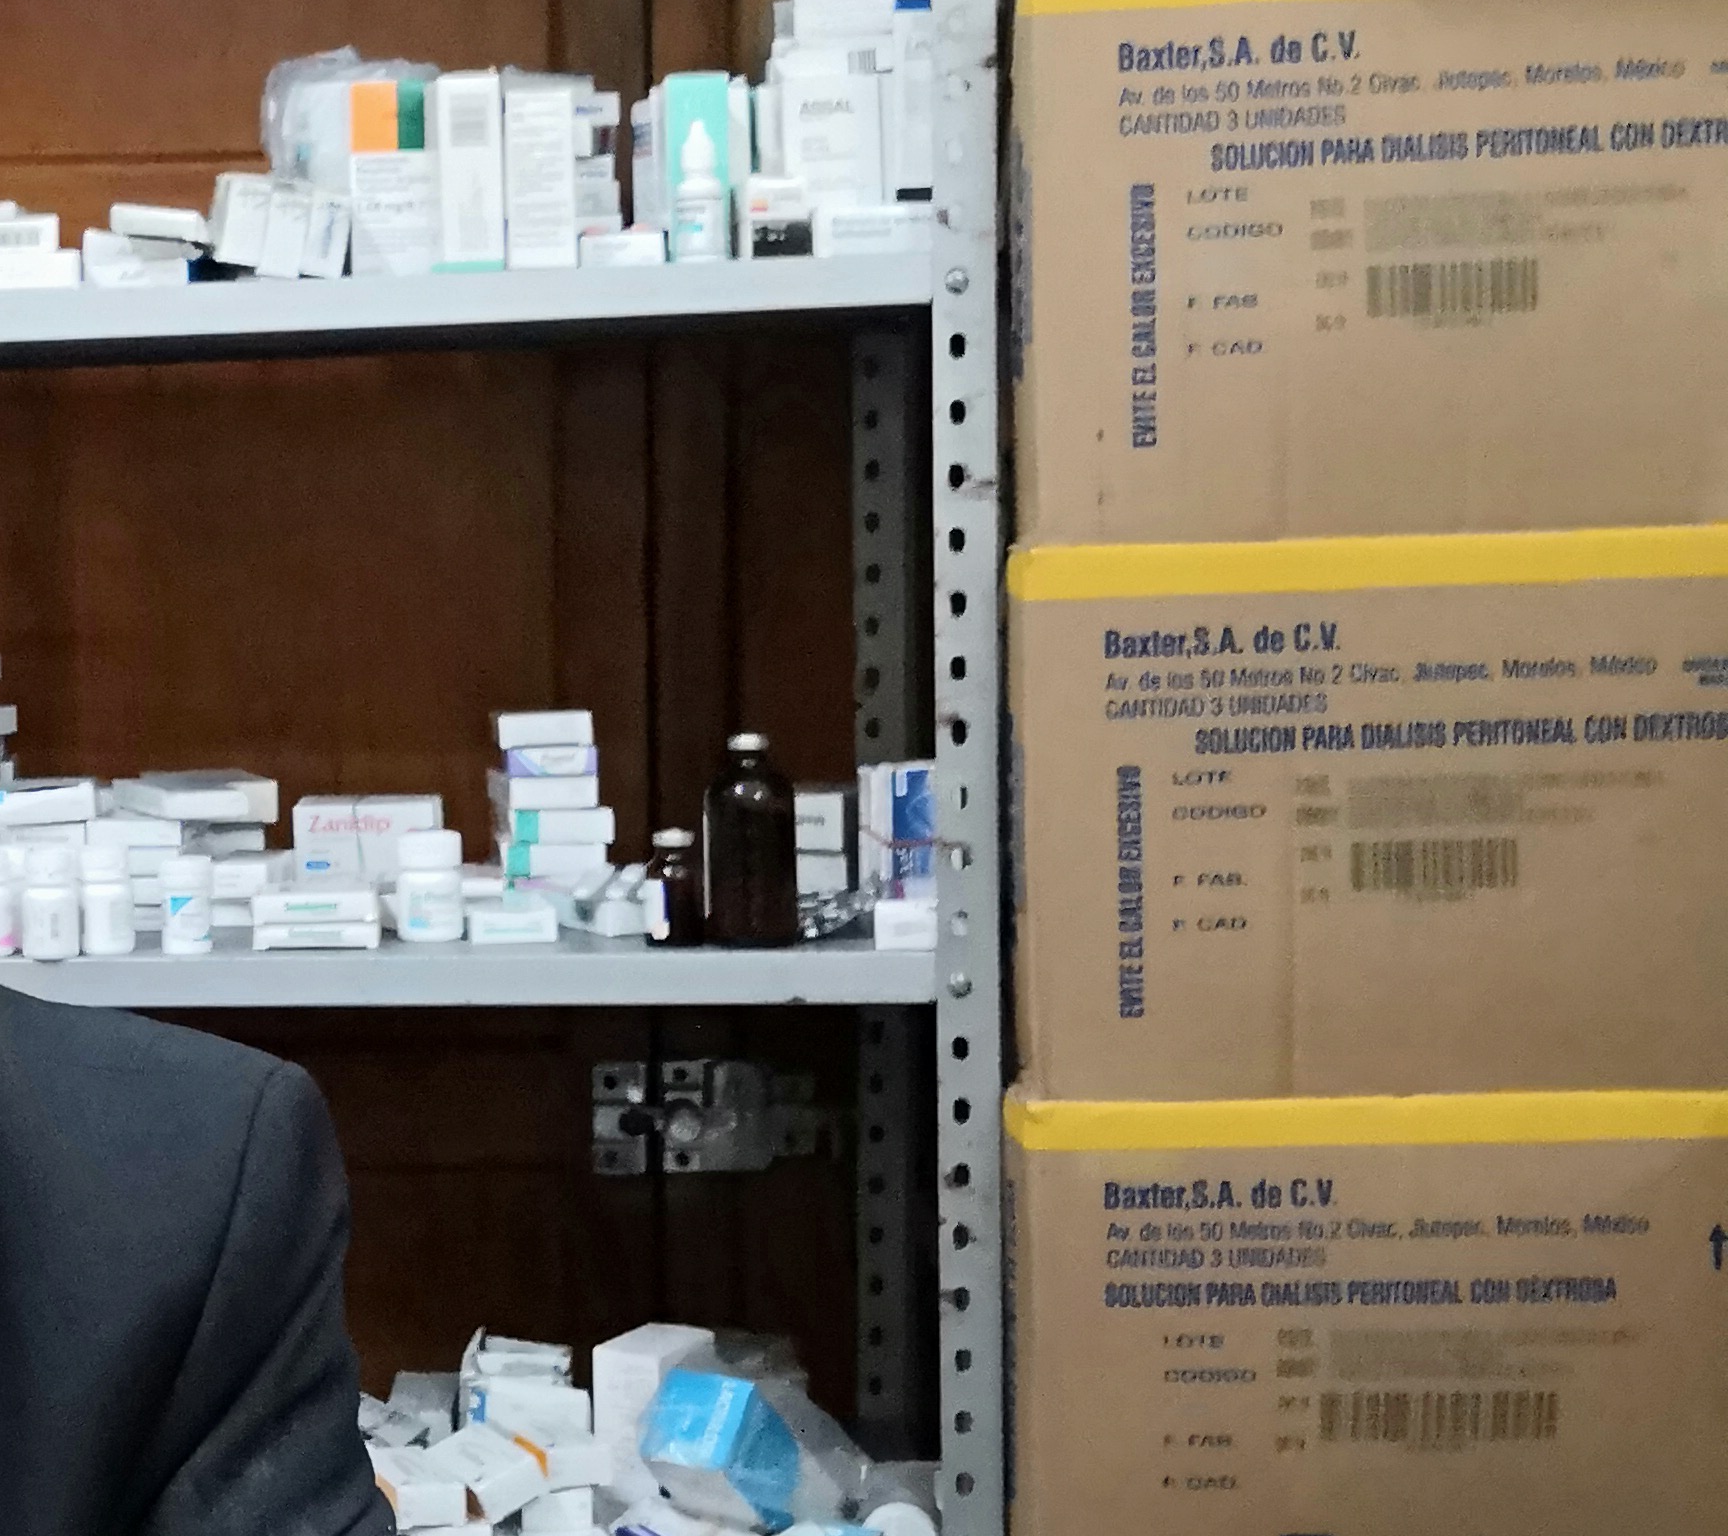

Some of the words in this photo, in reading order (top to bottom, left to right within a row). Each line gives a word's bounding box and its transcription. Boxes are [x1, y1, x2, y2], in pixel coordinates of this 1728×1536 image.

[1270, 33, 1302, 64] de
[1311, 30, 1362, 63] C.V.
[1119, 111, 1221, 137] CANTIDAD
[1226, 109, 1239, 132] 3
[1210, 140, 1314, 173] SOLUCION
[1321, 136, 1375, 166] PARA
[1610, 120, 1655, 152] CON
[1186, 186, 1249, 205] LOTE
[1186, 221, 1283, 242] CODIGO
[1252, 624, 1285, 655] de
[1293, 621, 1341, 653] C.V.
[1209, 695, 1223, 717] 3
[1195, 725, 1297, 755] SOLUCION
[1302, 723, 1355, 752] PARA
[1584, 714, 1627, 744] CON
[1172, 803, 1268, 821] CODIGO
[1250, 1179, 1282, 1210] de
[1210, 1248, 1222, 1268] 3
[1104, 1282, 1202, 1308] SOLUCION
[1205, 1282, 1256, 1307] PARA
[1470, 1277, 1510, 1304] CON
